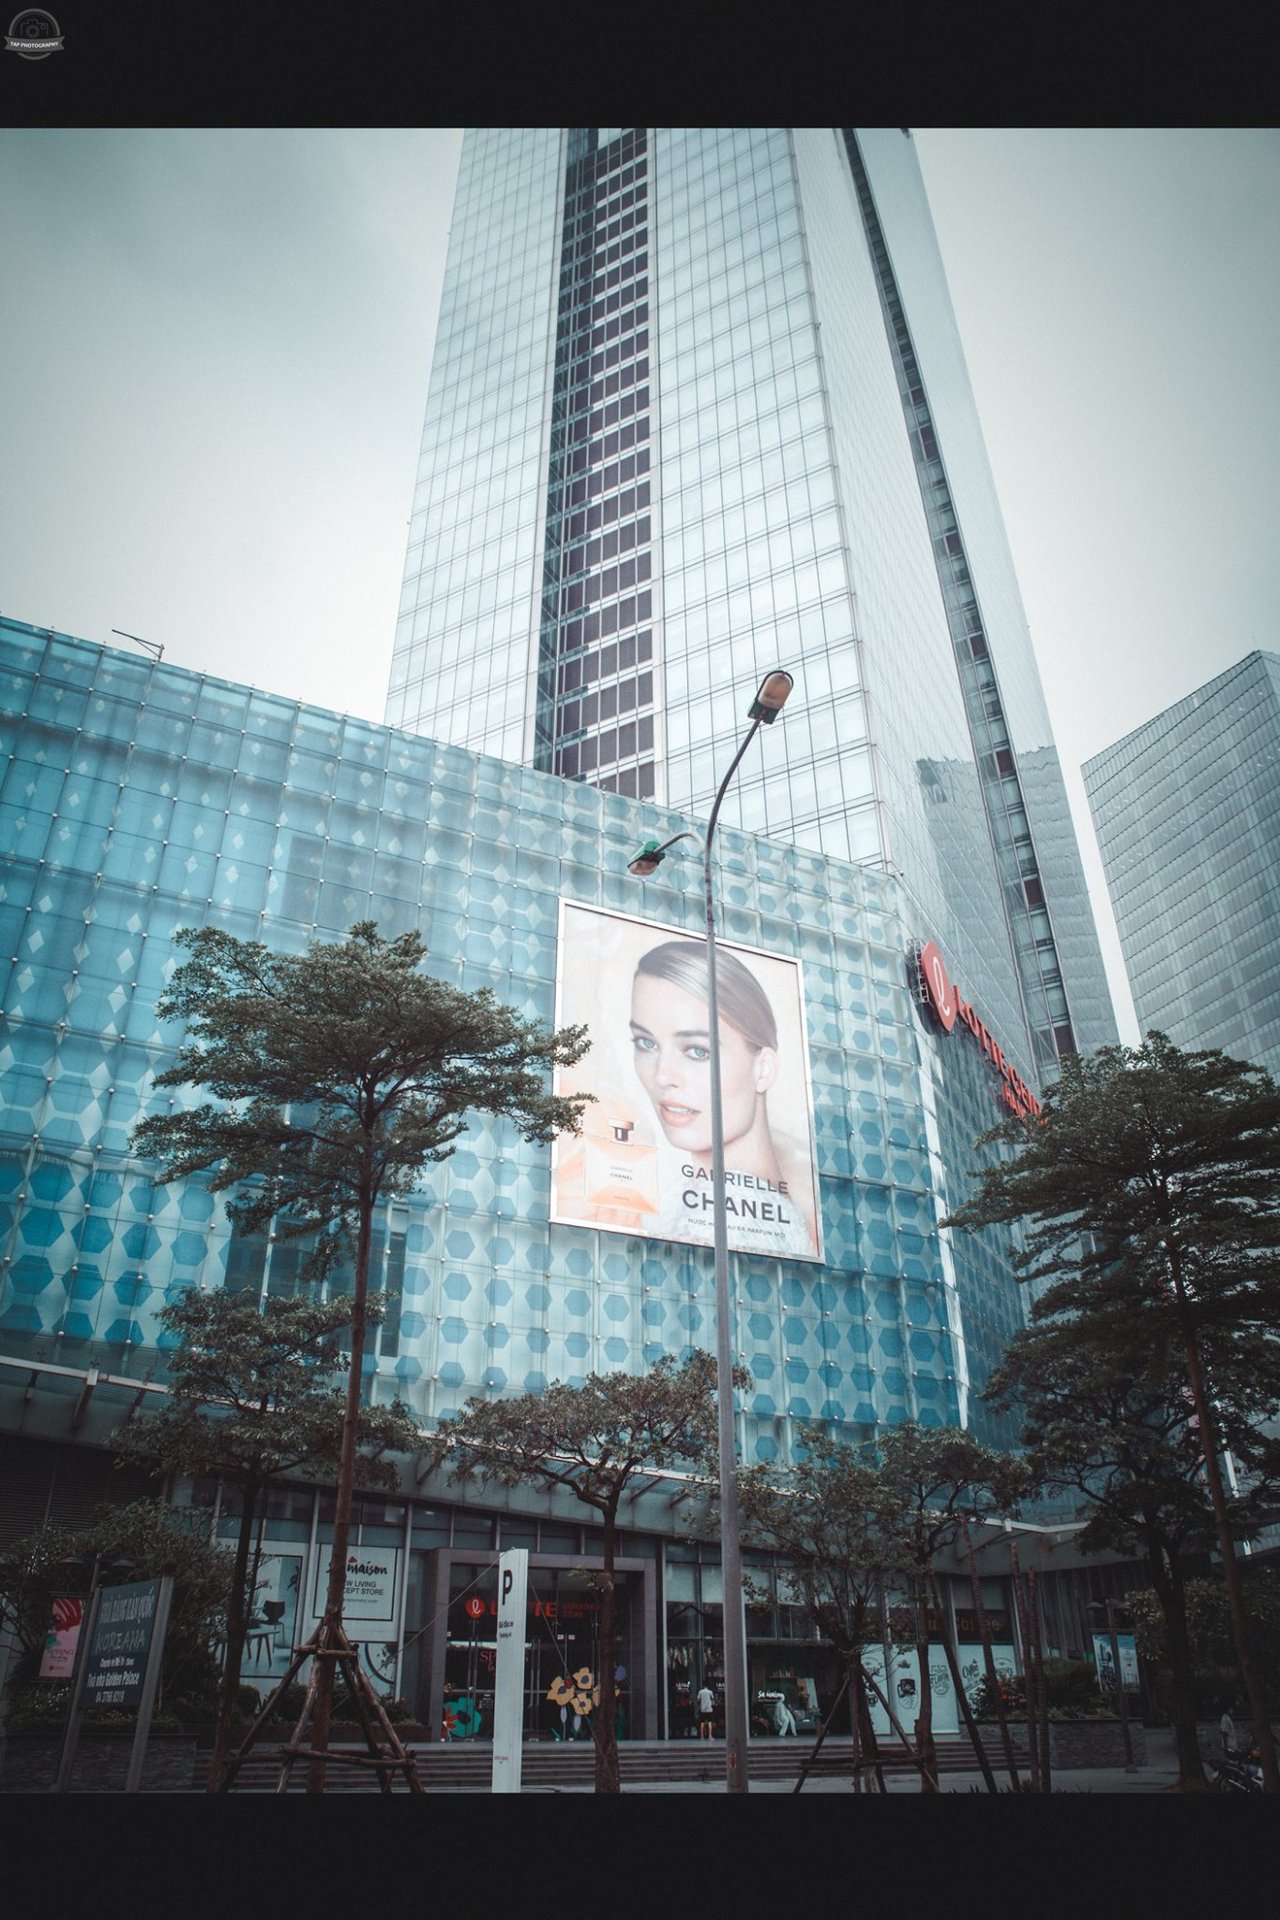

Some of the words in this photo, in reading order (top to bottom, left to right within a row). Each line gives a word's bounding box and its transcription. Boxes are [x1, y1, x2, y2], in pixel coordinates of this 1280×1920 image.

[681, 1164, 789, 1195] GARIELLE
[682, 1189, 791, 1225] CHANEL
[746, 1227, 773, 1236] PARFUM
[347, 1560, 388, 1576] maison
[354, 1580, 378, 1589] LIVING
[361, 1588, 385, 1597] STORE
[502, 1569, 514, 1606] P
[489, 1599, 558, 1618] LTE
[95, 1629, 146, 1655] KOREANA
[122, 1669, 140, 1686] Palace
